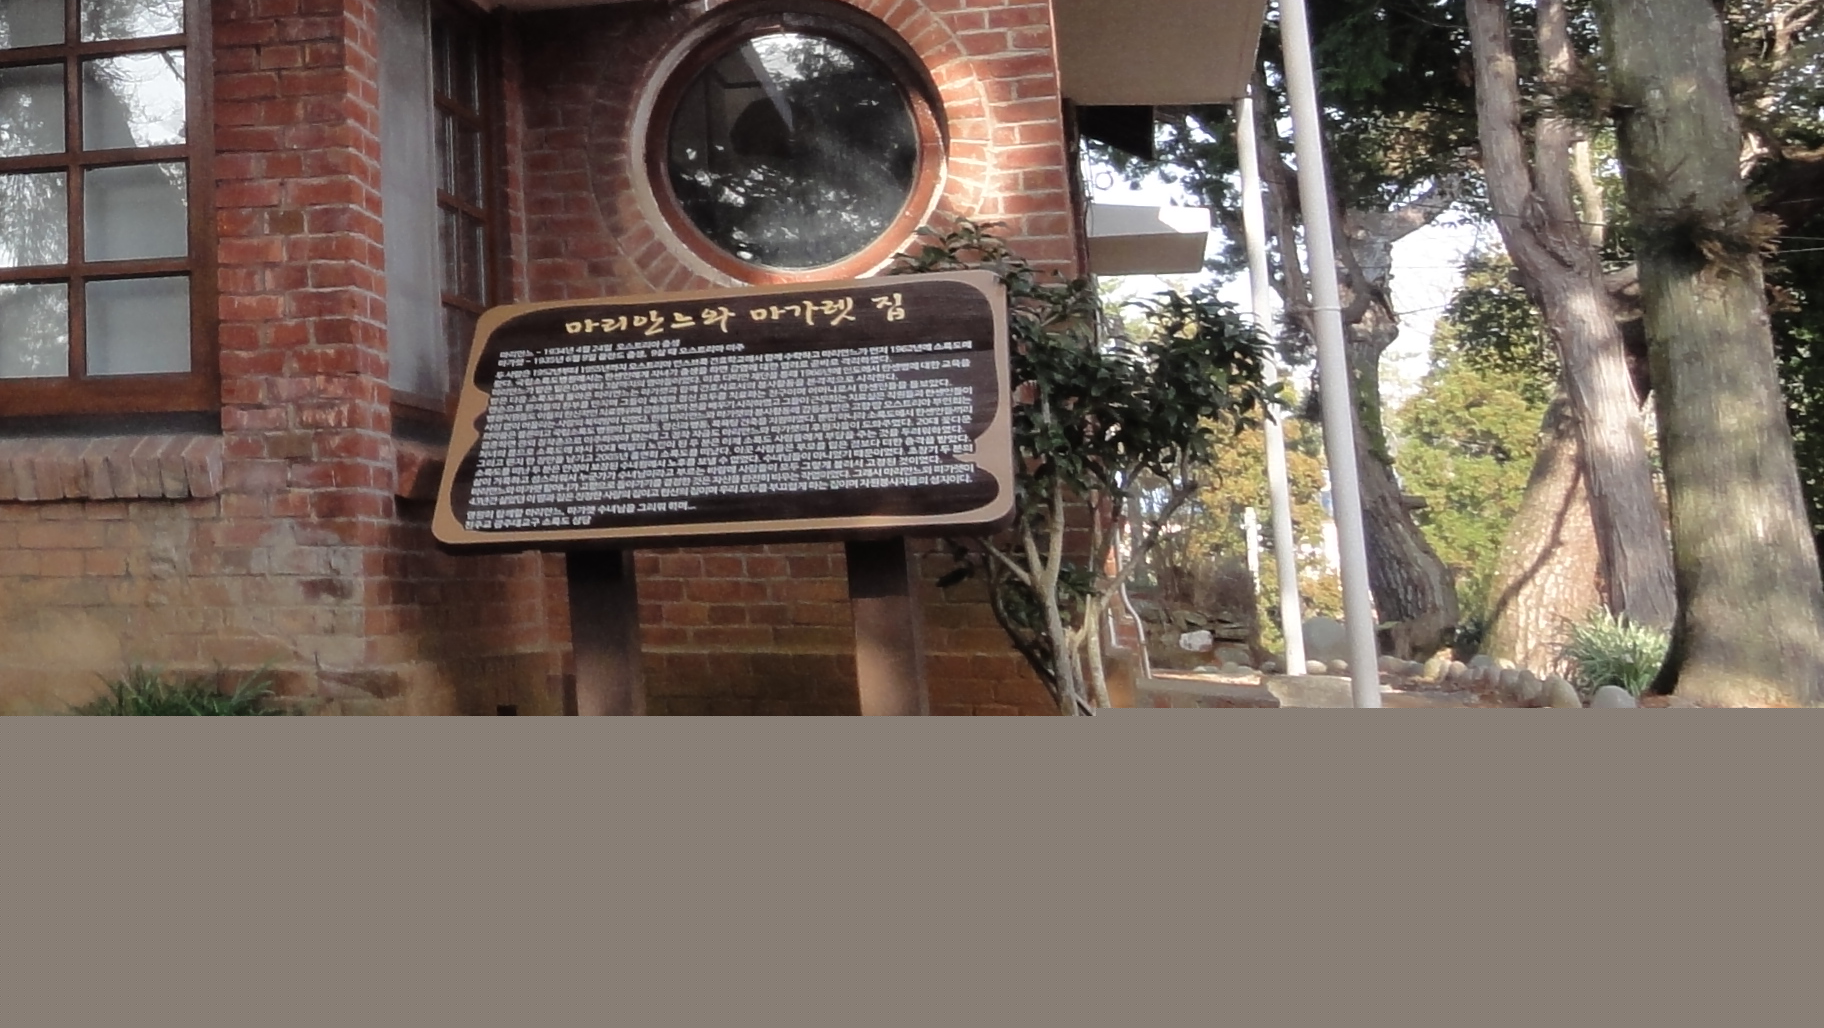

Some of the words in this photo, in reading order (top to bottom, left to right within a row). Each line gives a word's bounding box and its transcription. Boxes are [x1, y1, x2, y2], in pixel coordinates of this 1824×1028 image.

[565, 306, 736, 336] 마리안느와
[750, 297, 856, 326] 마가렛
[871, 293, 906, 321] 집
